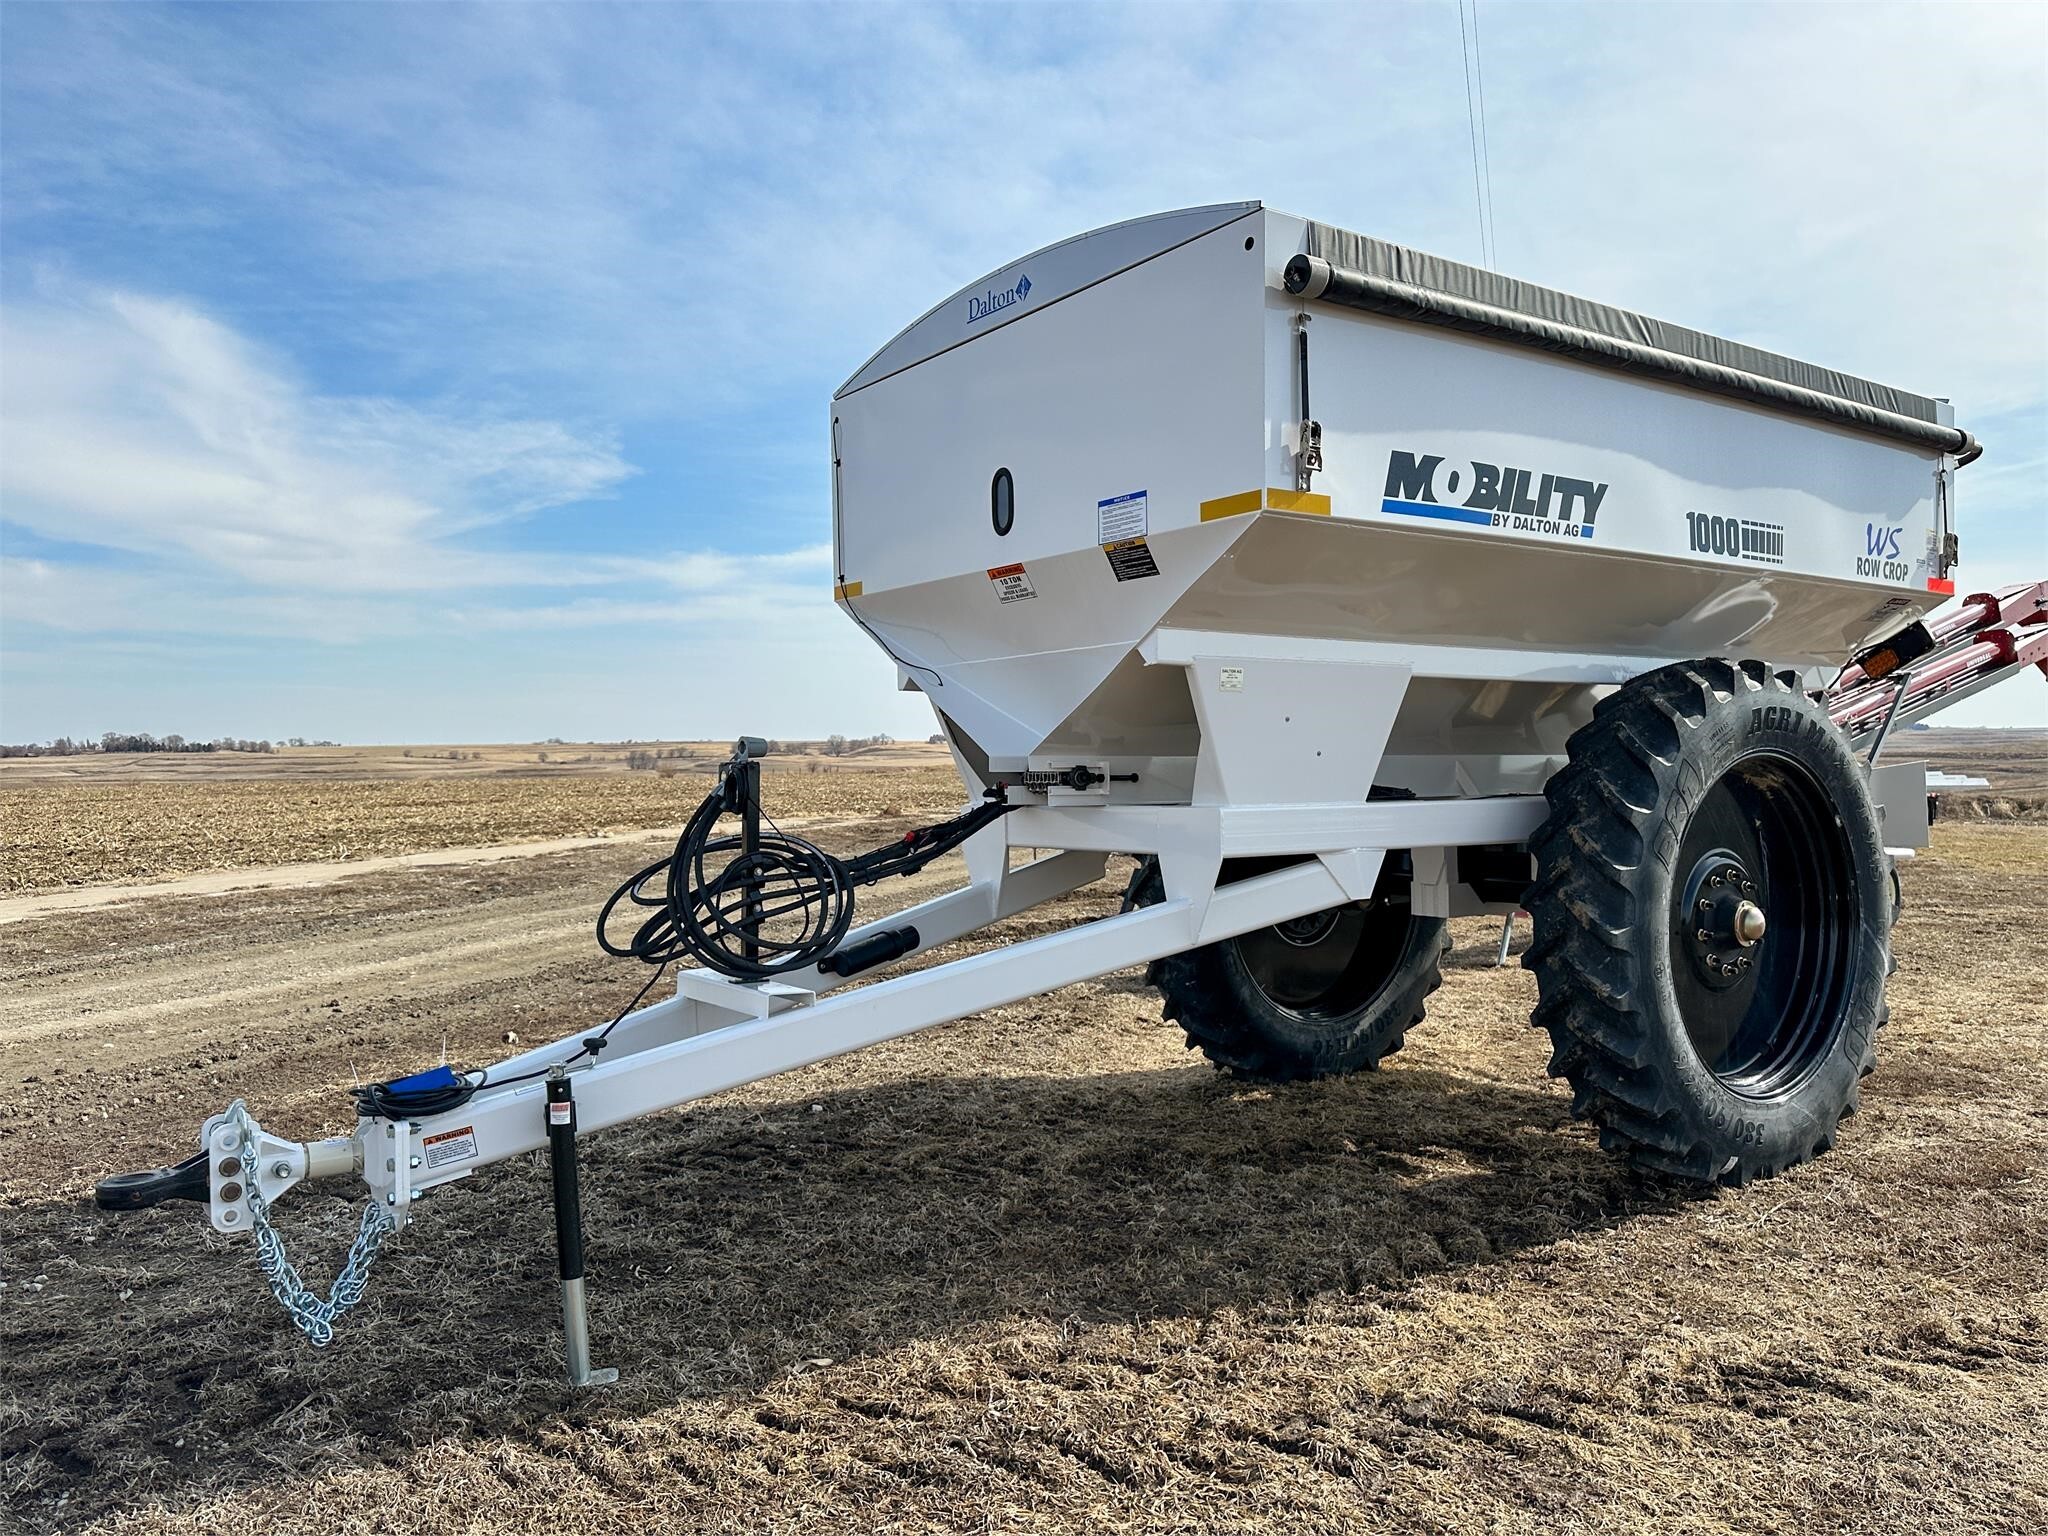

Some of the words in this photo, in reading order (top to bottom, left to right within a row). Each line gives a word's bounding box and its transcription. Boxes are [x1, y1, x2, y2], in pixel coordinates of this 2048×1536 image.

[968, 287, 1016, 321] Dalton
[1384, 450, 1609, 525] MOBILITY
[1491, 513, 1511, 528] BY
[1512, 514, 1560, 535] DALTON
[1563, 523, 1580, 537] AG
[1686, 511, 1741, 557] 1000
[1866, 522, 1903, 560] WS
[996, 565, 1023, 577] WARNING
[1008, 576, 1022, 584] TON
[1856, 557, 1881, 578] ROW
[1883, 562, 1909, 582] CROP
[434, 1127, 470, 1143] WARNING
